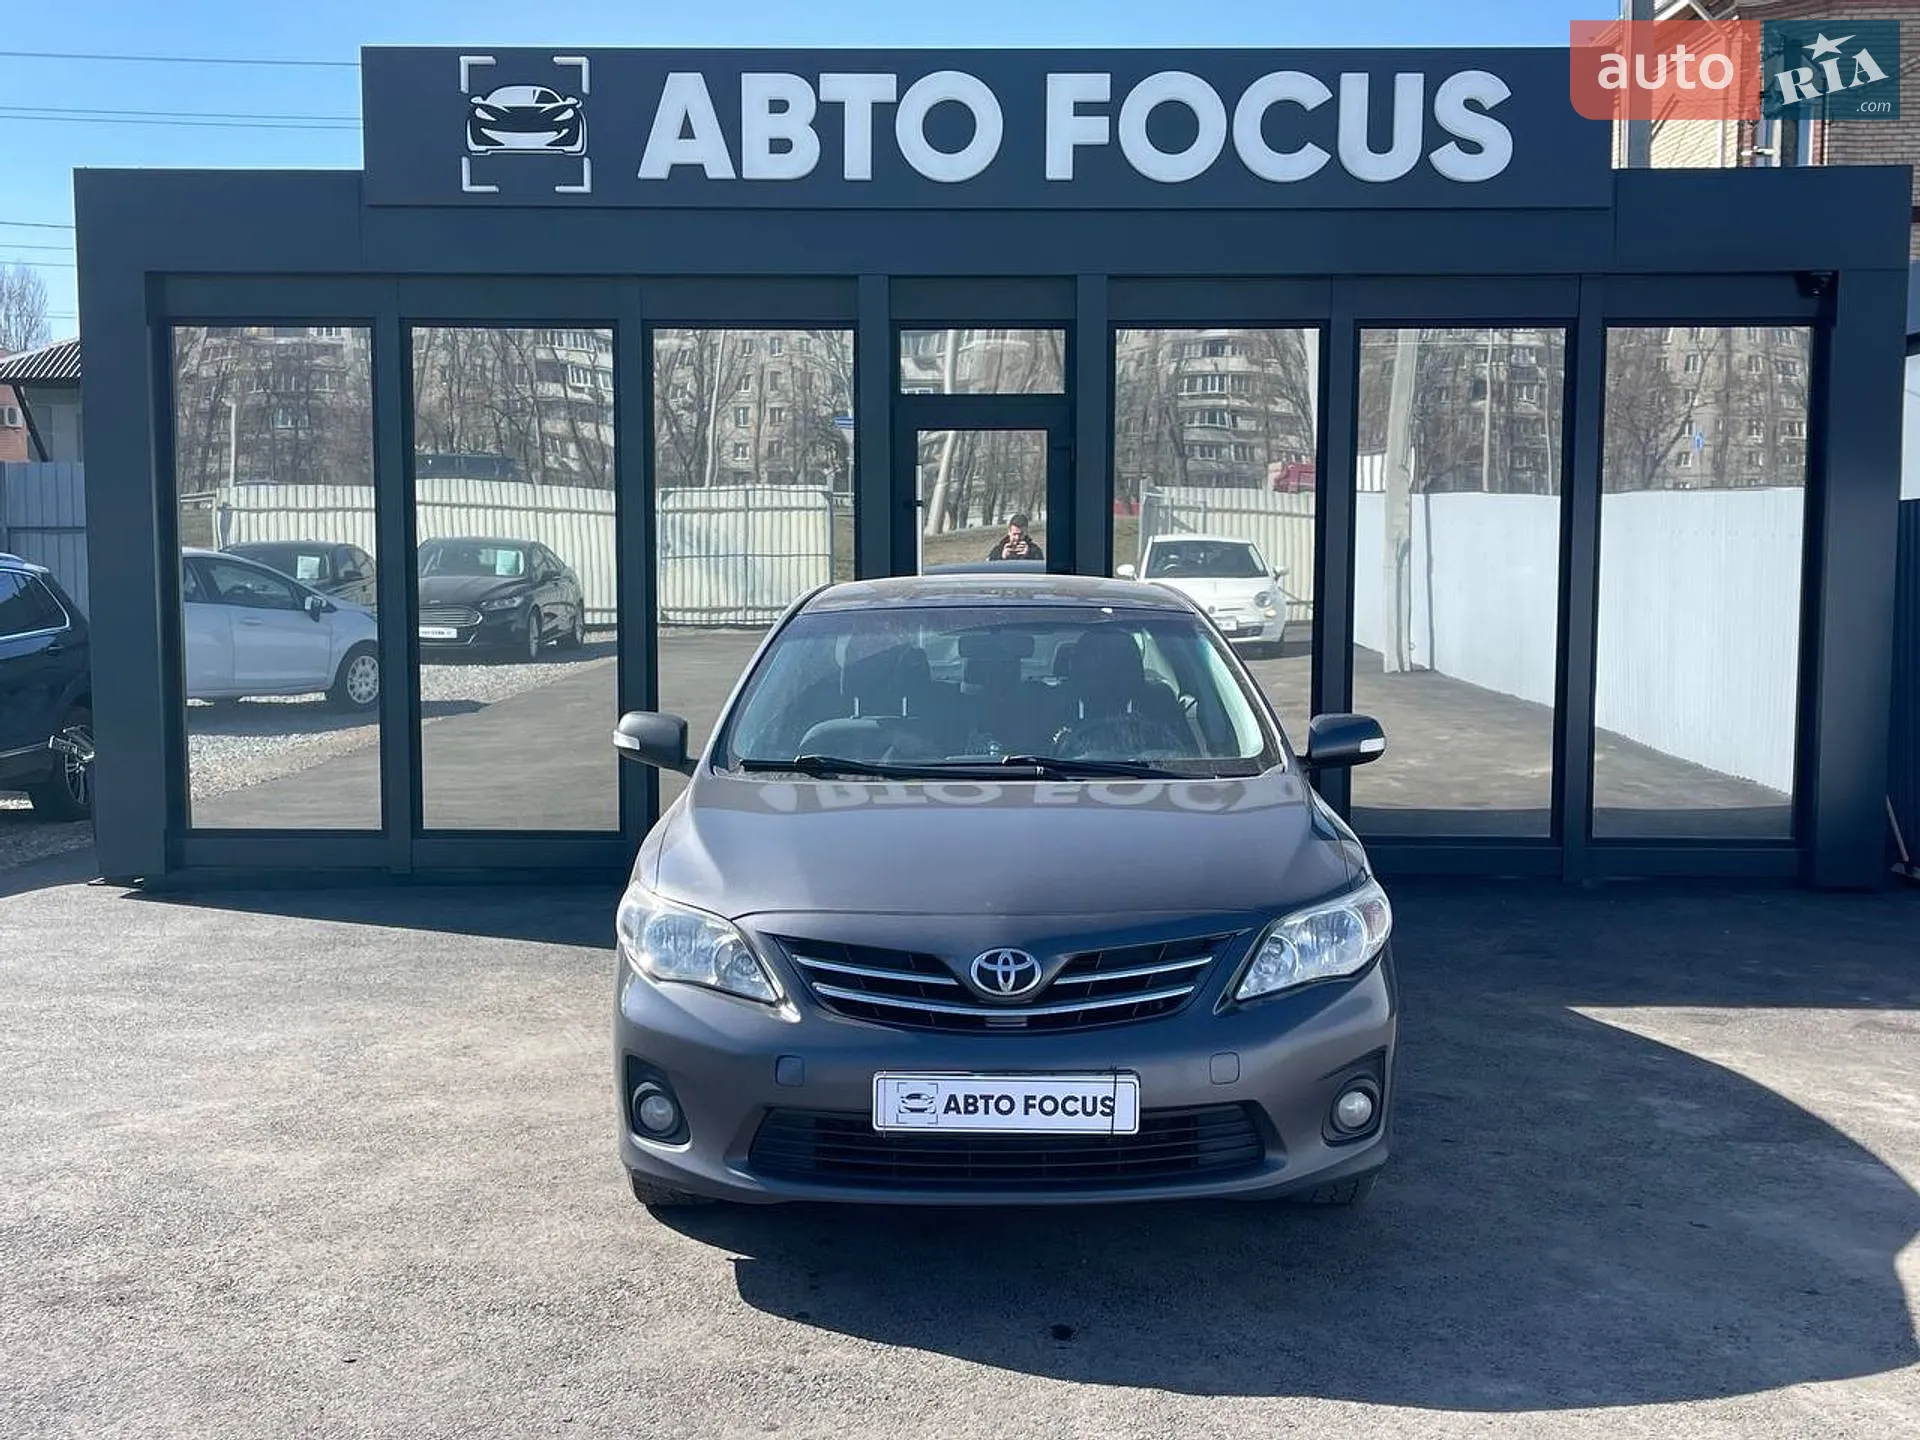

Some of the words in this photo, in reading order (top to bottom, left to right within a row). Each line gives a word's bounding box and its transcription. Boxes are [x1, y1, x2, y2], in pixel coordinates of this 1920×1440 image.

[637, 70, 1004, 183] АВТО
[1045, 70, 1513, 183] FOCUS
[943, 1093, 1016, 1116] АВТО
[1022, 1095, 1116, 1117] FOCUS
